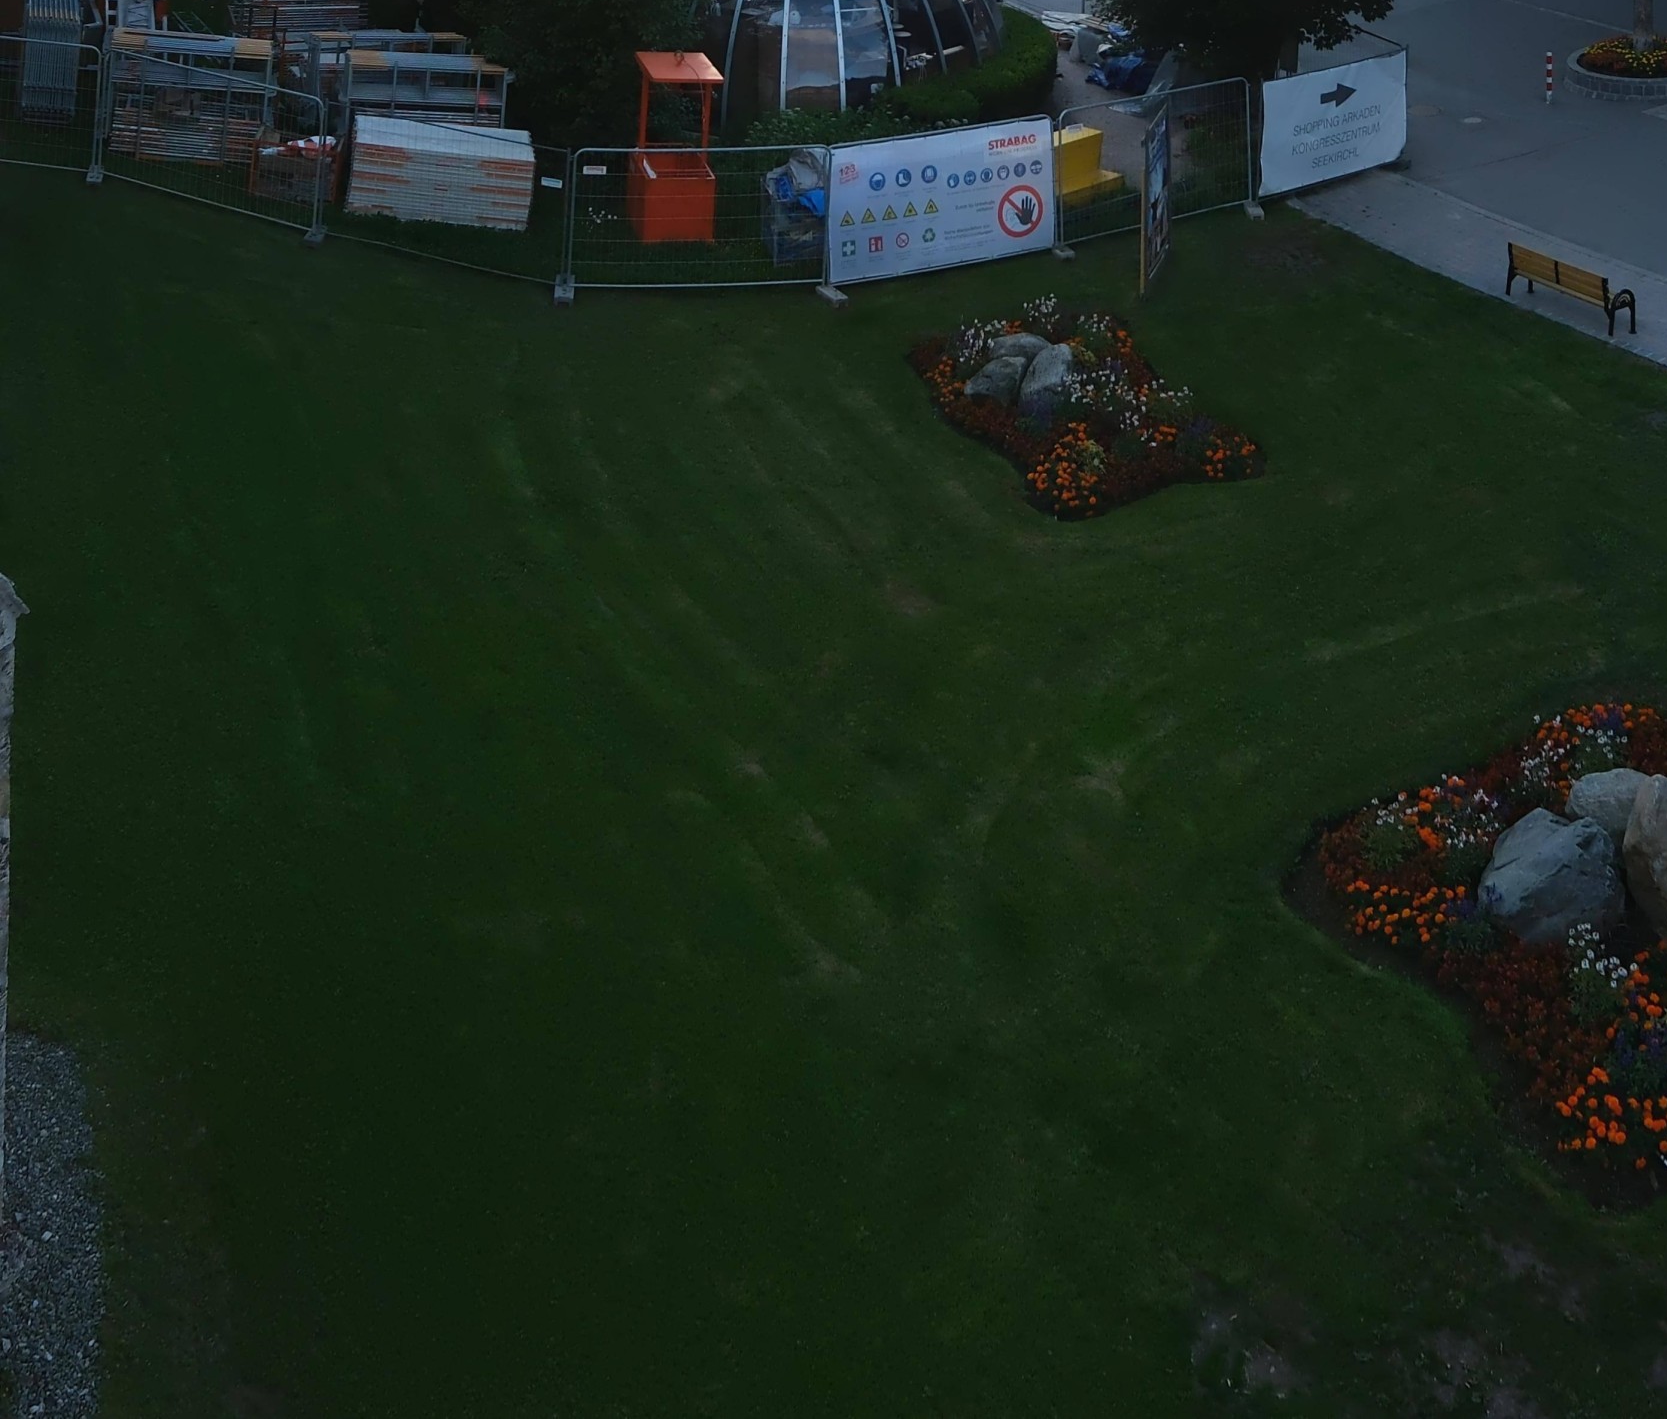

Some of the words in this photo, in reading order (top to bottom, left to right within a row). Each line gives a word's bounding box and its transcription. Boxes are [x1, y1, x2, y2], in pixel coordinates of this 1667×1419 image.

[1293, 115, 1339, 137] SHOPPING
[1342, 104, 1381, 123] ARKADEN
[988, 134, 1037, 151] STRABAG
